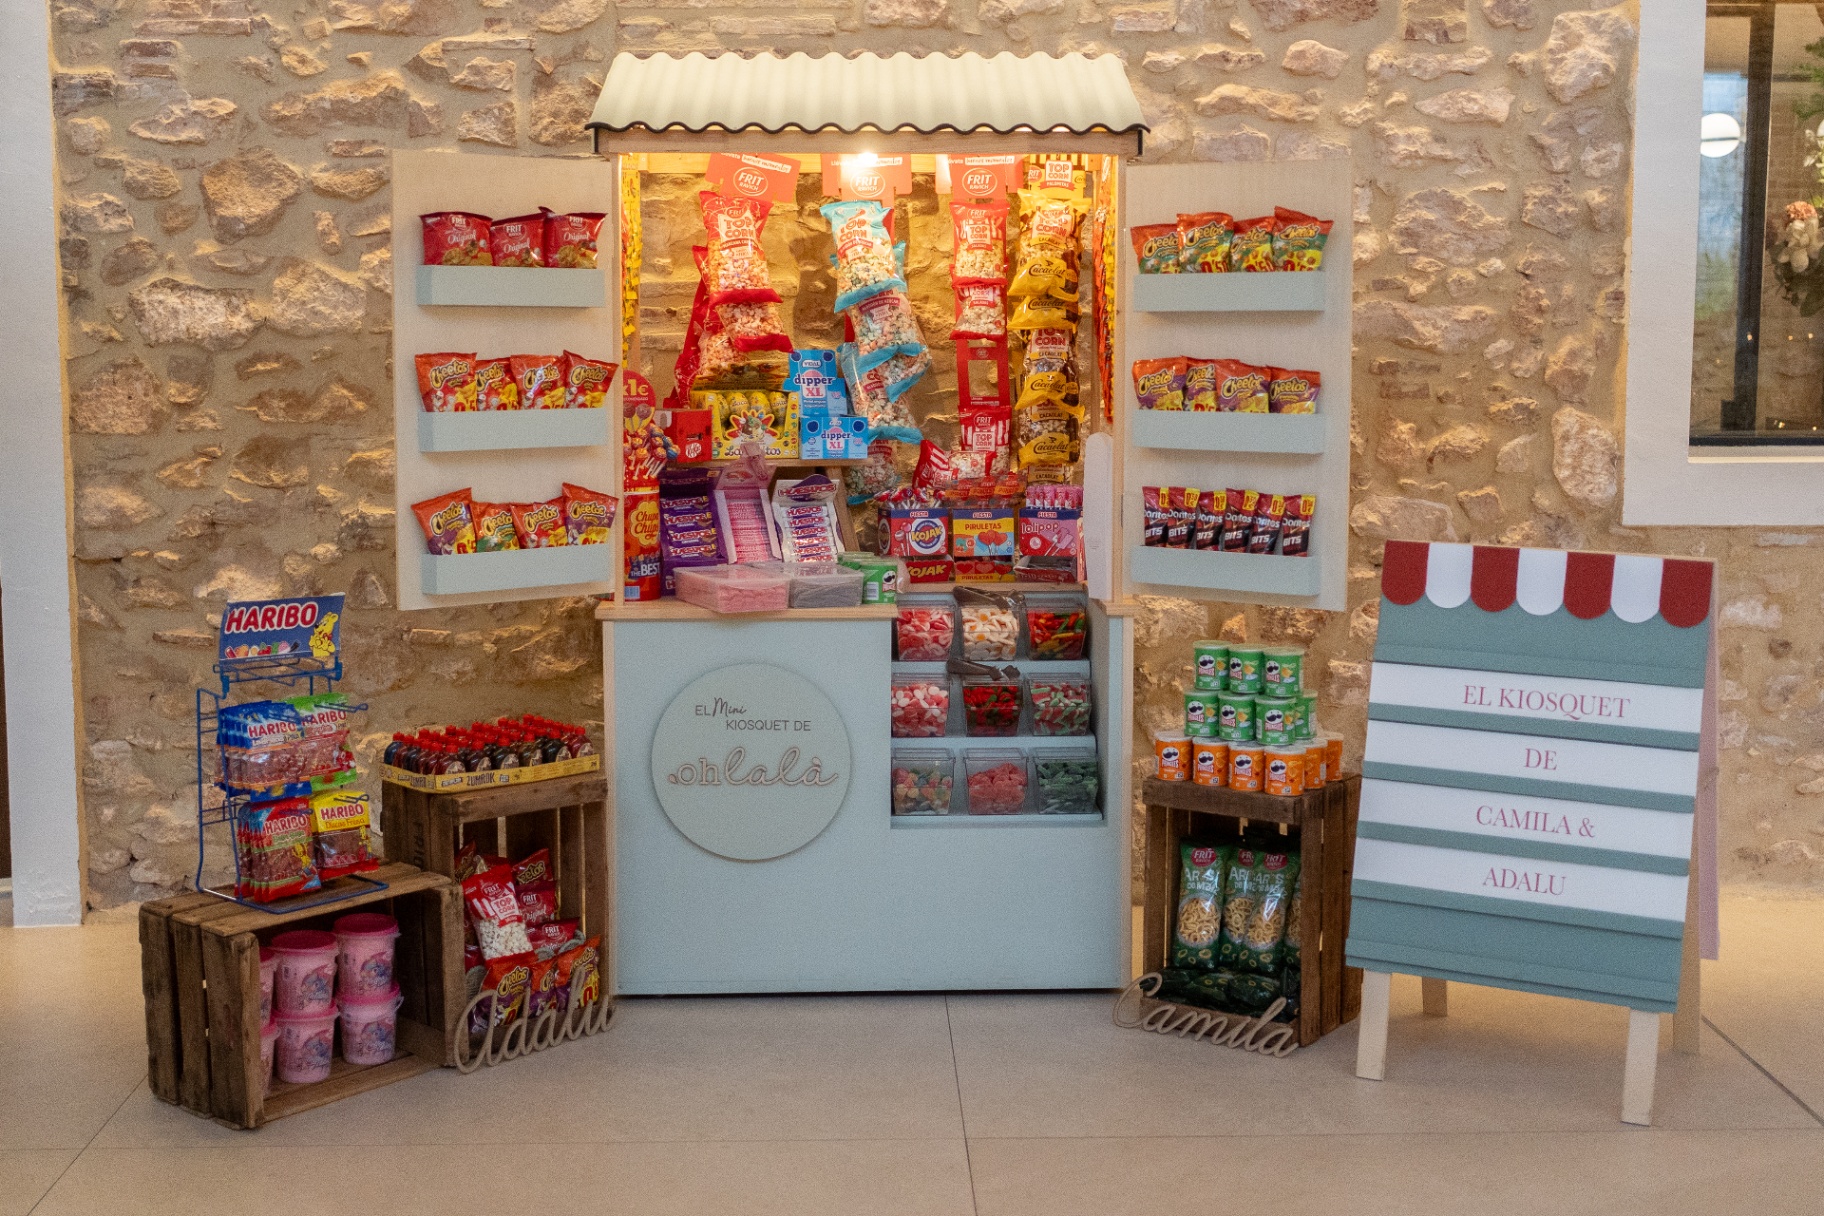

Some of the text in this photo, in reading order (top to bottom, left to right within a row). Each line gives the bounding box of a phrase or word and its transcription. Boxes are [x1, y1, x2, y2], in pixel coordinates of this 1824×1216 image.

[1028, 169, 1040, 177] RIT
[1048, 162, 1069, 173] TOP
[738, 172, 764, 186] FRIT
[855, 176, 880, 186] FRIT
[967, 174, 992, 184] FRIT
[1048, 172, 1069, 180] CORN
[739, 182, 759, 191] RAVICH
[451, 216, 467, 225] FRIT
[569, 216, 583, 224] FRIT
[724, 216, 752, 229] TOP
[506, 224, 522, 233] FRIT
[725, 229, 754, 238] CORN
[1036, 223, 1067, 238] CORN
[1278, 224, 1320, 241] Cheetos
[447, 231, 477, 247] Original
[563, 231, 590, 243] Original
[840, 230, 867, 242] CORN
[1185, 221, 1225, 249] Cheetos
[503, 238, 531, 255] Original
[1143, 231, 1179, 259] Cheeto
[1035, 337, 1066, 346] CORN
[430, 358, 469, 390] Cheetos
[570, 365, 608, 386] Cheetos
[794, 373, 833, 386] dipper
[1186, 363, 1216, 388] Cheeto
[1137, 368, 1175, 398] Cheetos
[1221, 373, 1265, 400] Cheetos
[806, 387, 823, 397] XL
[1270, 377, 1309, 402] Cheetos
[976, 416, 992, 424] FRIT
[821, 430, 851, 440] dipper
[829, 441, 843, 449] XL
[1033, 442, 1069, 455] Cacaolat
[570, 501, 607, 520] Cheetos
[972, 511, 993, 519] FIESTA
[1037, 511, 1058, 519] FIESTA
[1144, 509, 1168, 519] Dorito
[1168, 509, 1196, 521] Doritos
[431, 501, 465, 537] Cheetos
[523, 505, 560, 534] Cheetos
[1225, 512, 1252, 523] Doritos
[1283, 518, 1311, 528] Doritos
[481, 511, 513, 537] Cheeto
[1021, 521, 1059, 535] lolipop
[910, 524, 944, 542] KOJAK
[1145, 526, 1163, 537] BITS
[1168, 525, 1187, 537] BITS
[1196, 530, 1213, 540] BITS
[1225, 530, 1243, 540] BITS
[1251, 534, 1270, 544] BITS
[1283, 536, 1302, 546] BITS
[224, 601, 319, 634] HARIBO
[695, 697, 748, 718] EL Mini
[1463, 684, 1631, 721] EL KIOSQUET
[248, 721, 297, 738] HARIBO
[726, 719, 811, 732] KIOSQUET DE
[1524, 748, 1558, 771] DE
[320, 803, 365, 820] HARIBO
[264, 813, 308, 836] HARIBO
[1476, 805, 1596, 838] CAMILA &
[1194, 850, 1215, 859] FRIT
[1265, 854, 1285, 862] FRIT
[517, 861, 546, 884] eetos
[1482, 867, 1567, 896] ADALU
[484, 884, 500, 895] FRIT
[494, 898, 511, 908] TOP
[523, 894, 537, 902] FRIT
[499, 904, 517, 914] CORN
[544, 925, 560, 934] FRIT
[498, 966, 531, 996] Cheetos
[1112, 971, 1299, 1058] Camila
